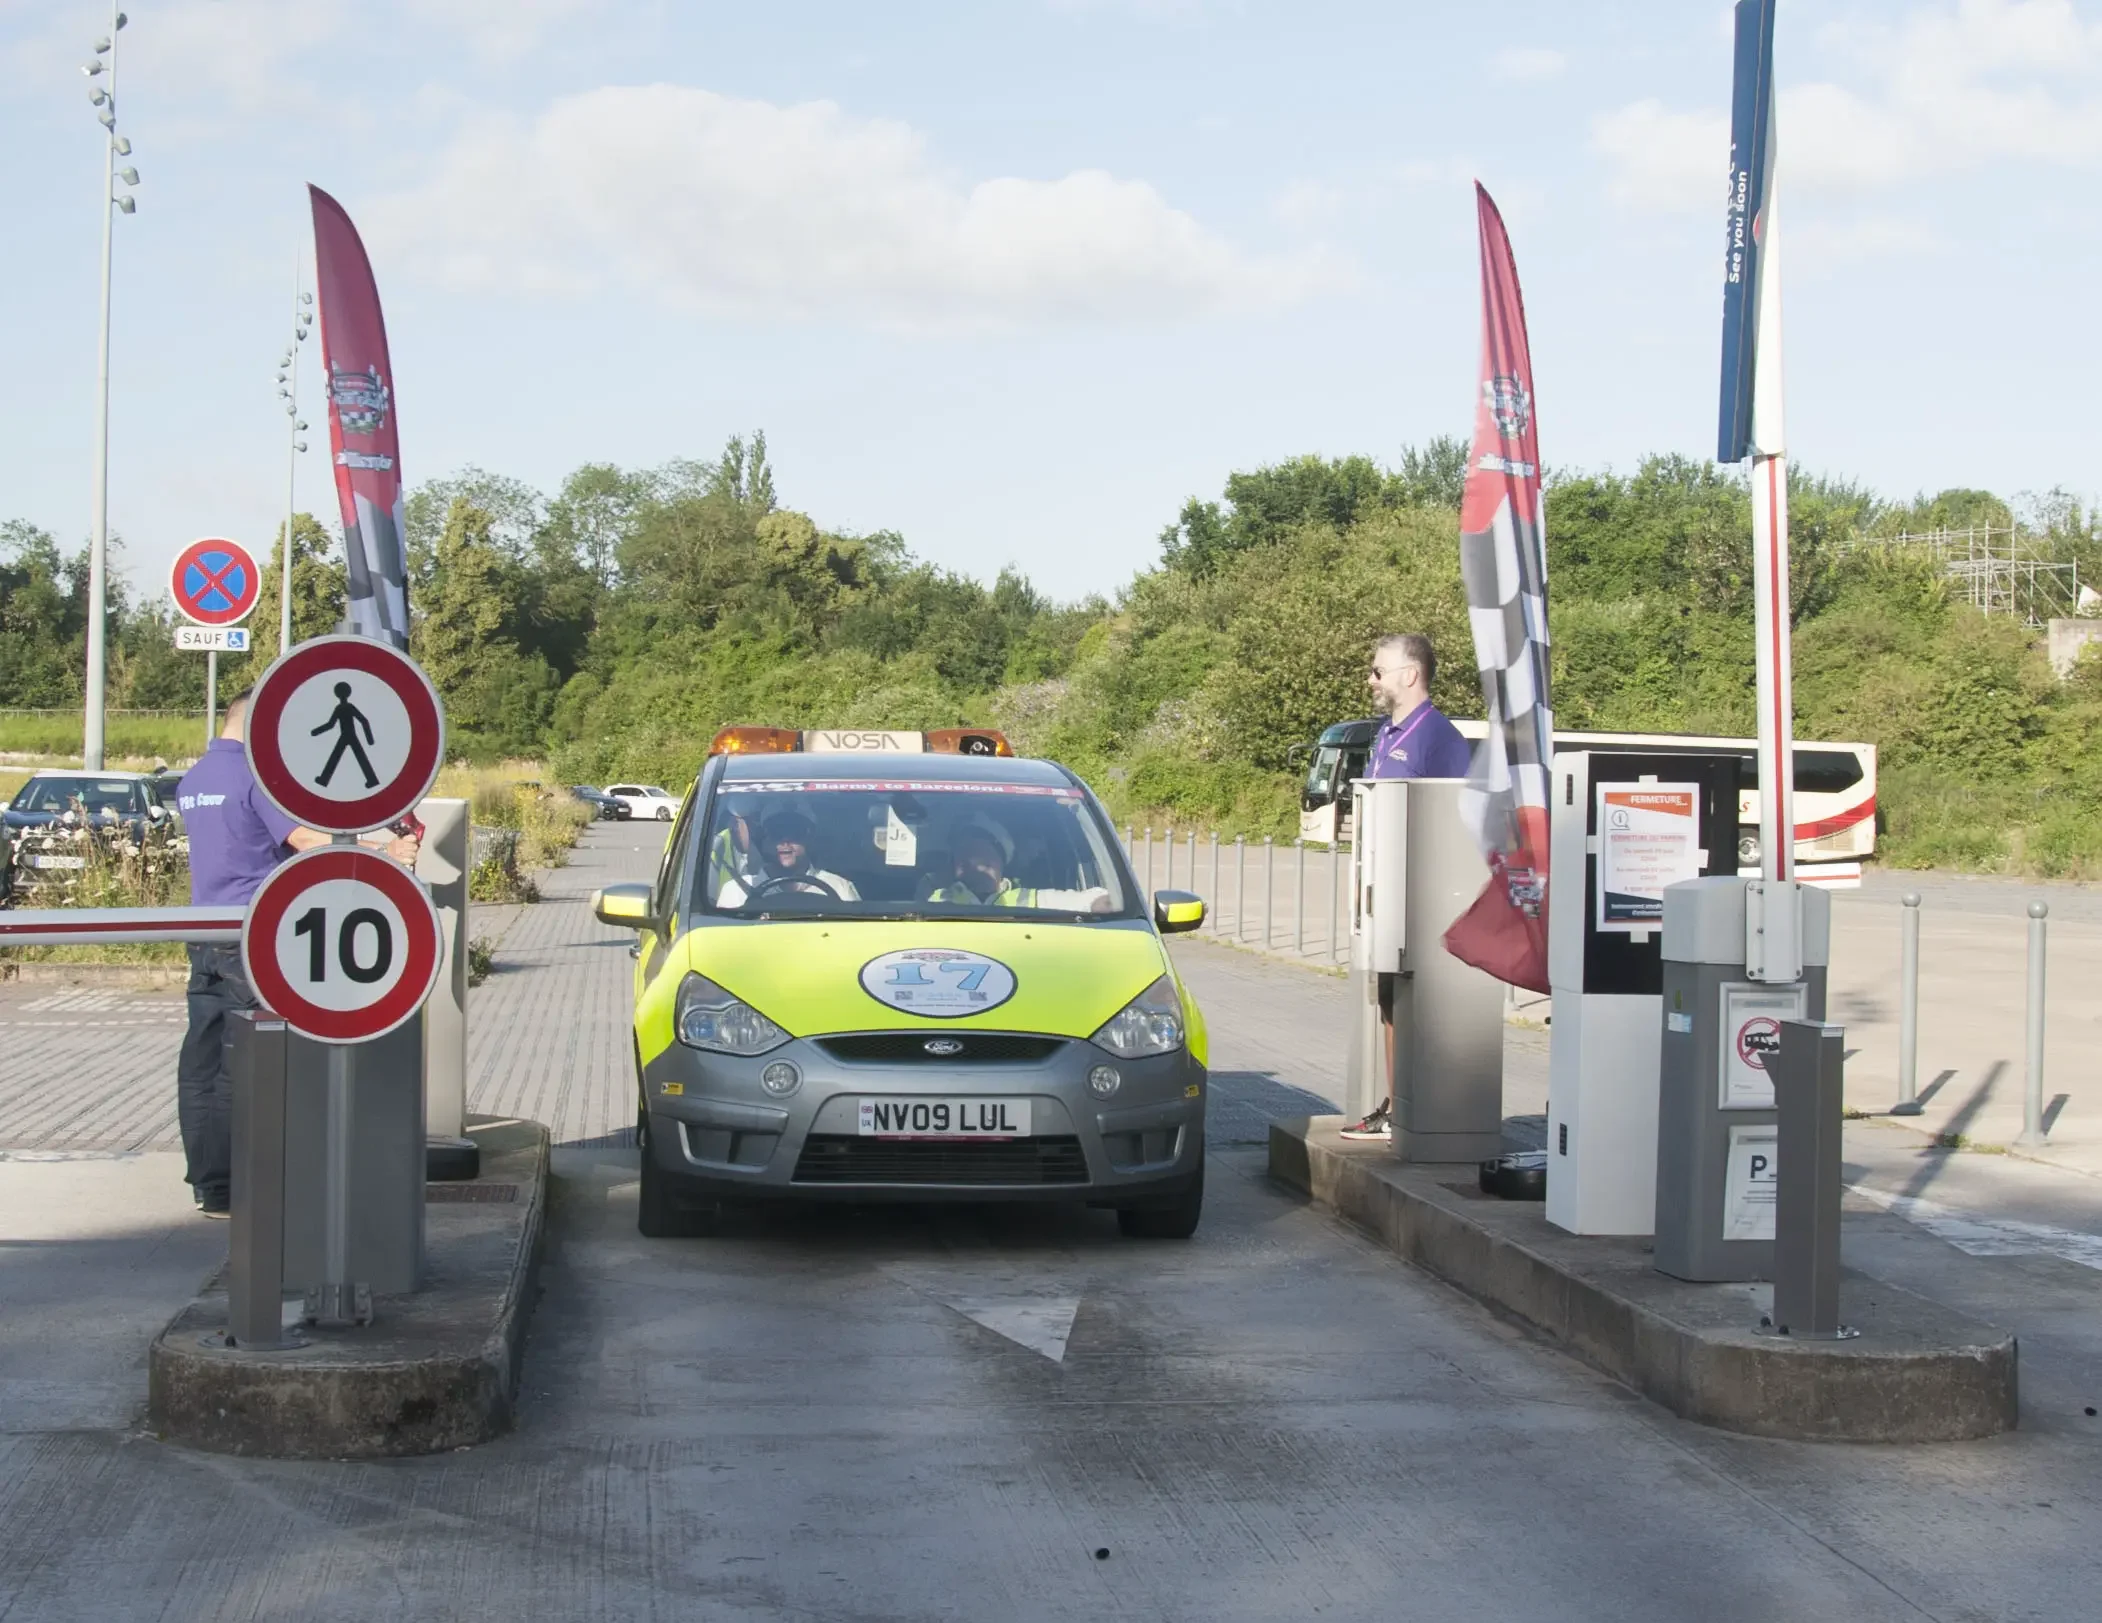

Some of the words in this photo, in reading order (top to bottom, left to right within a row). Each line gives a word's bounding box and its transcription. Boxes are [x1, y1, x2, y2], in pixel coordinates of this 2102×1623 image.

[1736, 171, 1748, 212] soon
[1733, 216, 1745, 248] you
[1728, 252, 1742, 284] See
[183, 633, 223, 645] SAUF
[822, 732, 900, 750] VOSA
[815, 783, 877, 792] Barmy
[883, 782, 905, 791] to
[909, 782, 1005, 793] Barcelona
[1630, 795, 1681, 804] FERMETURE
[295, 907, 393, 984] 10
[884, 962, 991, 991] 17
[873, 1103, 950, 1131] NV09
[959, 1103, 1017, 1131] LUL
